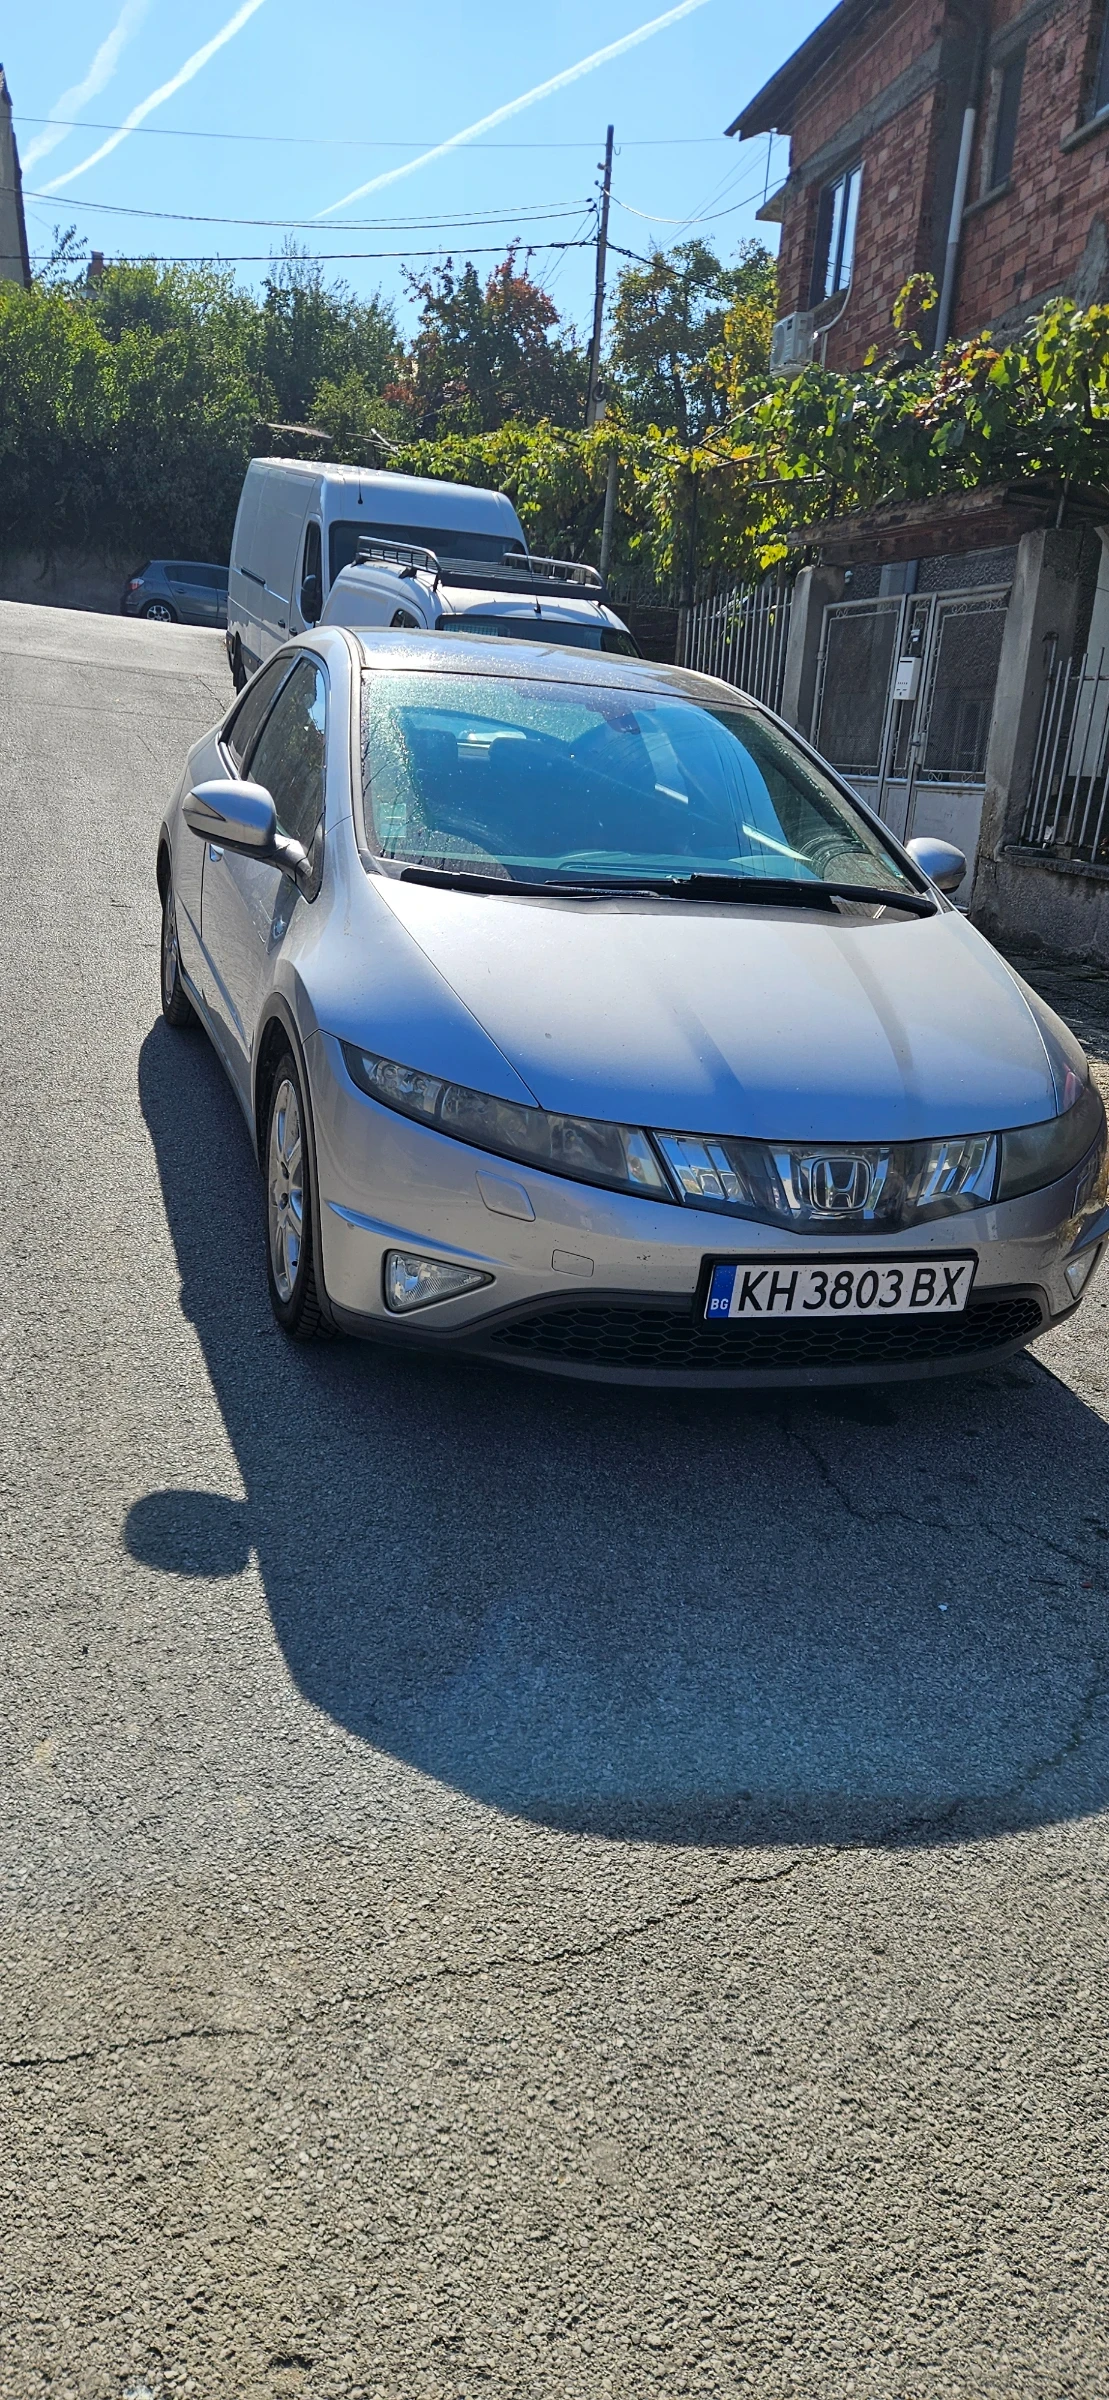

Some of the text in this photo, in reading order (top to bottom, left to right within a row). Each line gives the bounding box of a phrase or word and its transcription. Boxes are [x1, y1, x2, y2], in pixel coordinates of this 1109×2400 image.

[738, 1266, 966, 1312] KH 3803 BX
[710, 1298, 729, 1311] BG
